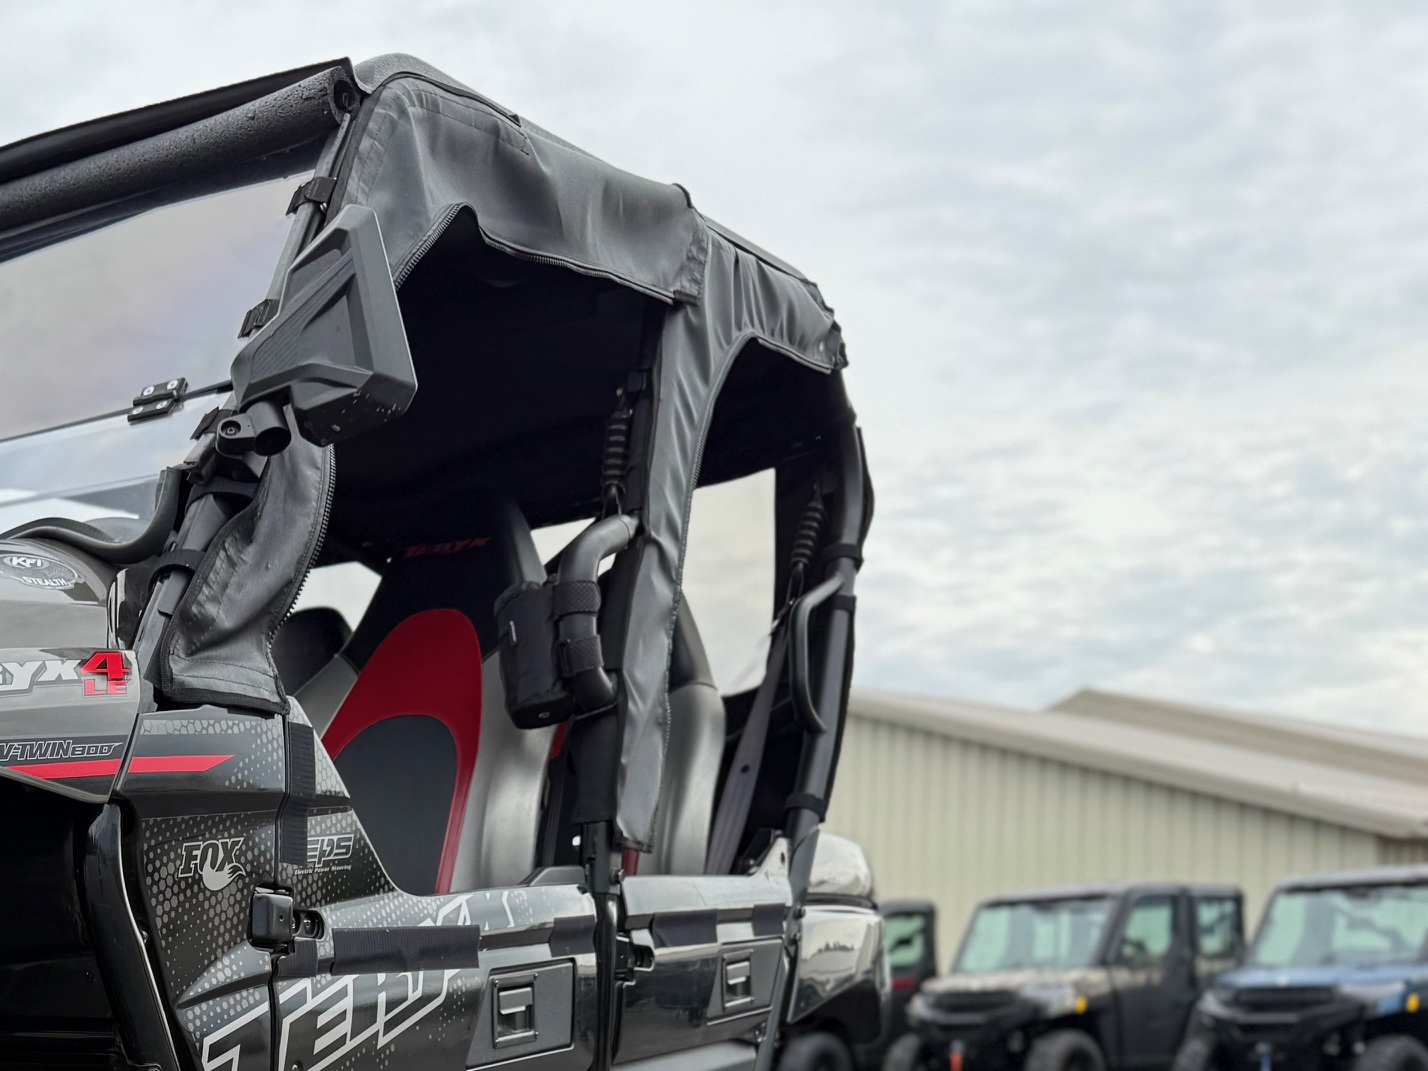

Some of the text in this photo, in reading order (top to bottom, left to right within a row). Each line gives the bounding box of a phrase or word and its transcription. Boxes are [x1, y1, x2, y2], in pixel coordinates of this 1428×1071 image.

[12, 556, 42, 568] KFI
[22, 576, 68, 587] STEALTH
[84, 679, 128, 696] LE
[178, 837, 245, 885] FOX
